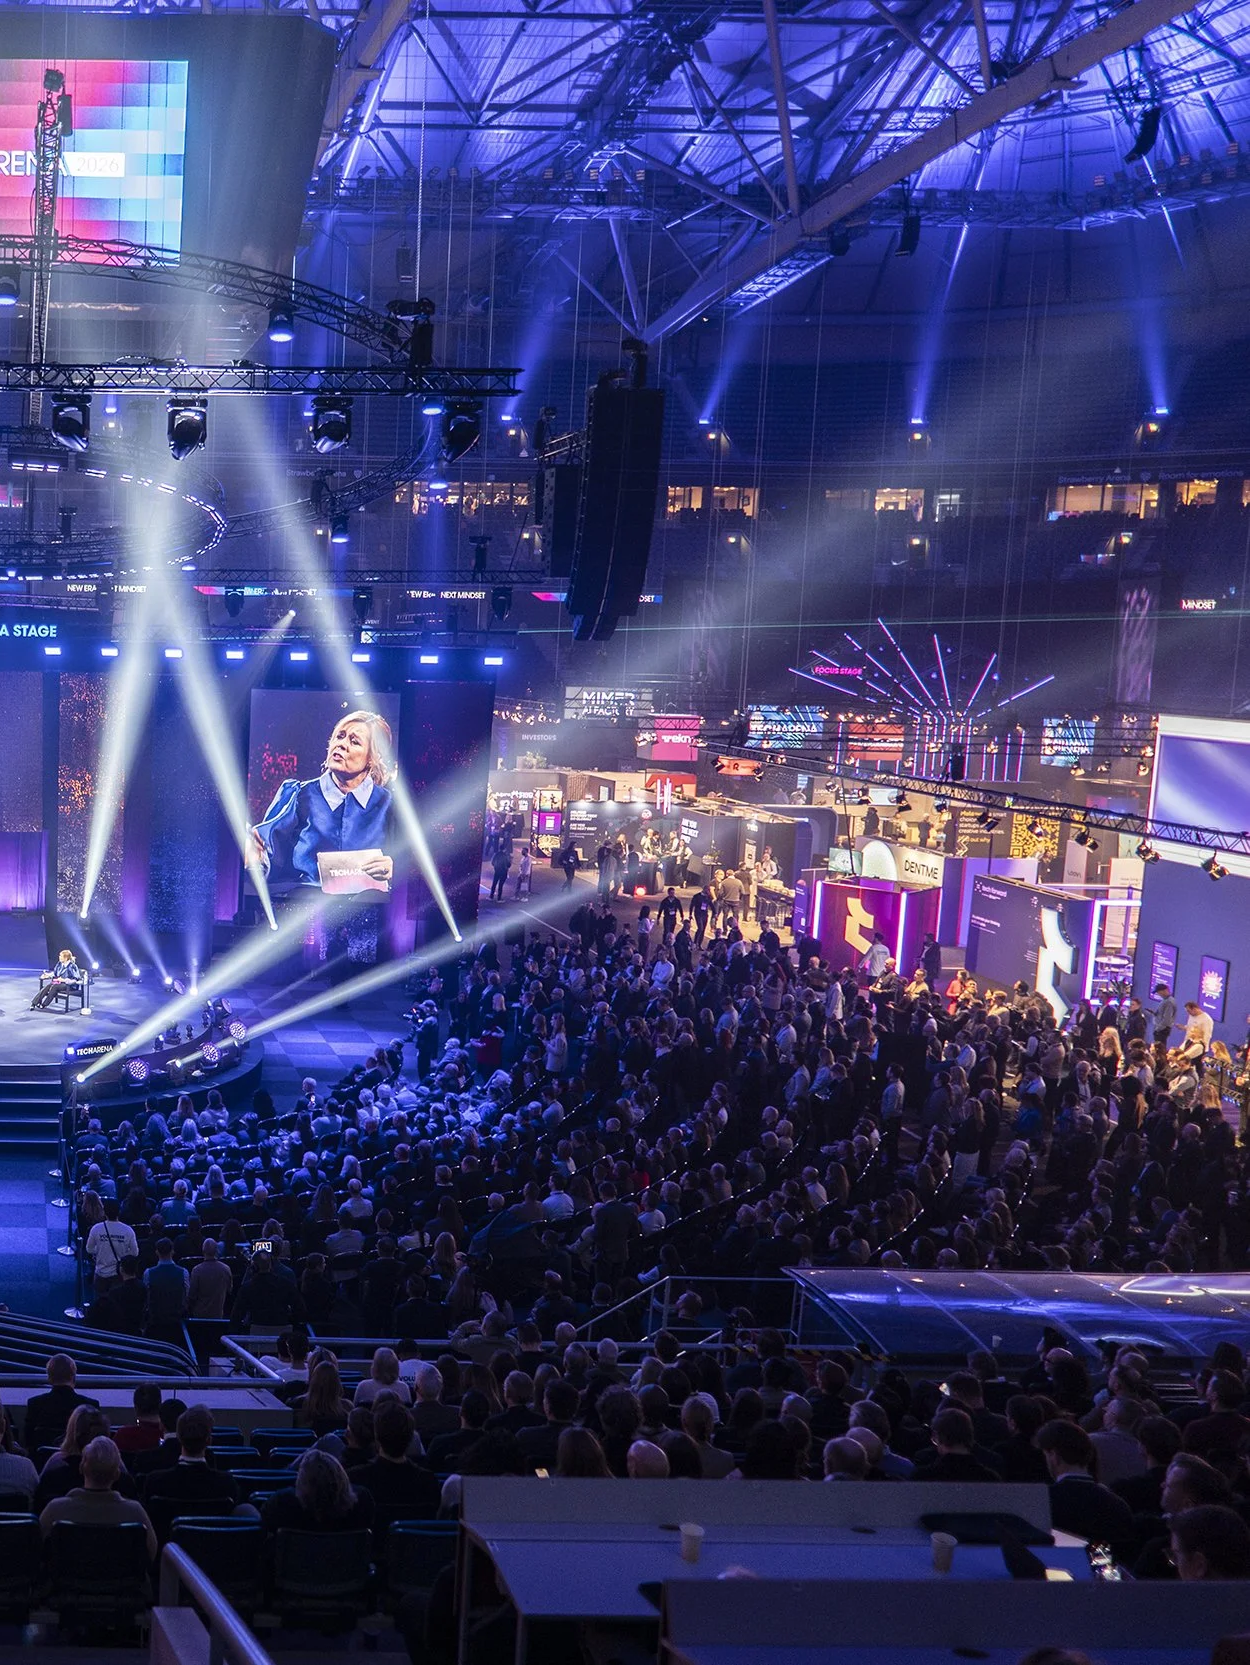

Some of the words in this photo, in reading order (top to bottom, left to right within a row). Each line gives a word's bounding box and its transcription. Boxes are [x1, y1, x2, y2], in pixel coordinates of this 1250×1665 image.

[76, 156, 119, 173] 2026
[67, 584, 83, 592] NEW
[118, 585, 147, 593] MINDSET
[440, 591, 456, 599] NEXT
[1181, 599, 1216, 610] MINDSET
[13, 624, 57, 638] STAGE
[815, 666, 839, 675] FOCUS
[840, 667, 862, 676] STAGE
[904, 860, 938, 880] DENTME
[76, 1045, 113, 1056] TECHARENA
